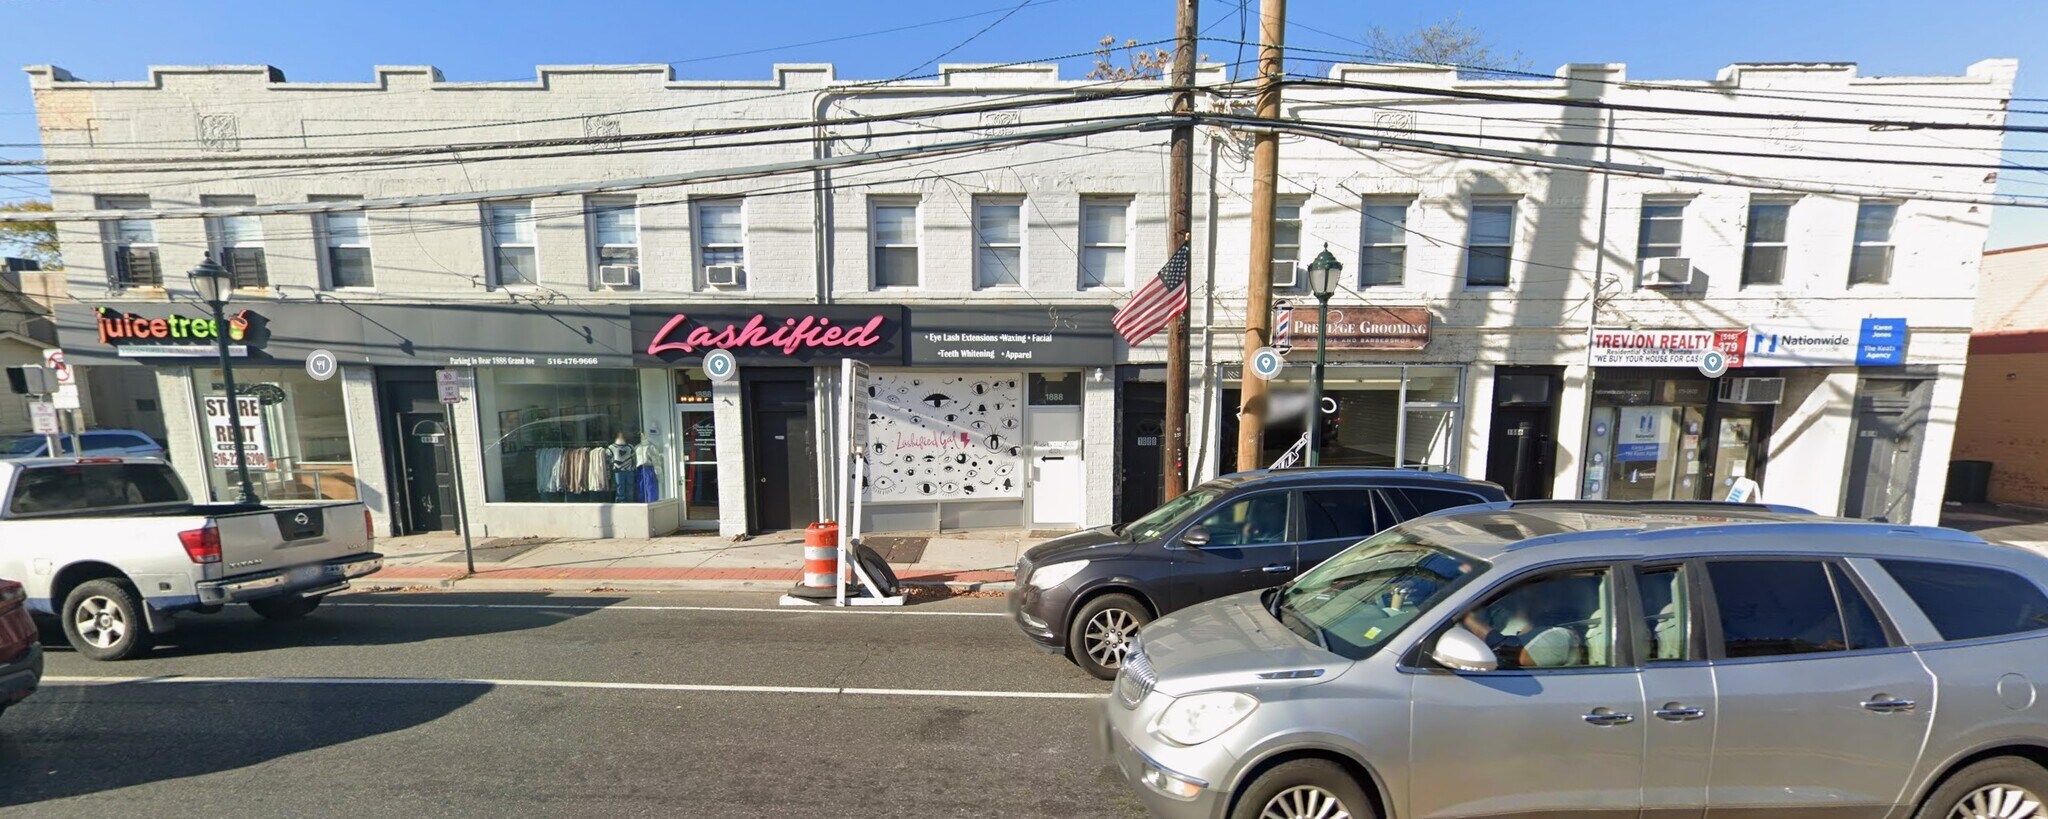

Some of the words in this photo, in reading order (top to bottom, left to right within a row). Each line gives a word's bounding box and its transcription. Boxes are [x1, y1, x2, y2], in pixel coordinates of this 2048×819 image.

[1359, 321, 1426, 334] GROOMING
[648, 313, 884, 355] Lashified
[929, 333, 942, 343] Eye
[943, 333, 960, 342] Lash
[961, 333, 998, 342] Extensions
[1032, 334, 1052, 342] Facial
[1596, 334, 1655, 349] TREVJON
[1660, 334, 1711, 349] REALTY
[1781, 335, 1850, 346] Nationwide
[1718, 342, 1738, 352] 379
[960, 350, 995, 359] Whitening
[1005, 350, 1032, 359] Apparel
[1609, 355, 1623, 363] BUY
[1625, 355, 1644, 363] YOUR
[1645, 355, 1668, 363] HOUSE
[1670, 355, 1684, 363] FOR
[450, 357, 471, 366] Parking
[508, 357, 525, 365] Grand
[1045, 393, 1064, 401] 1888
[206, 399, 259, 417] STRE
[229, 558, 263, 569] TITAN
